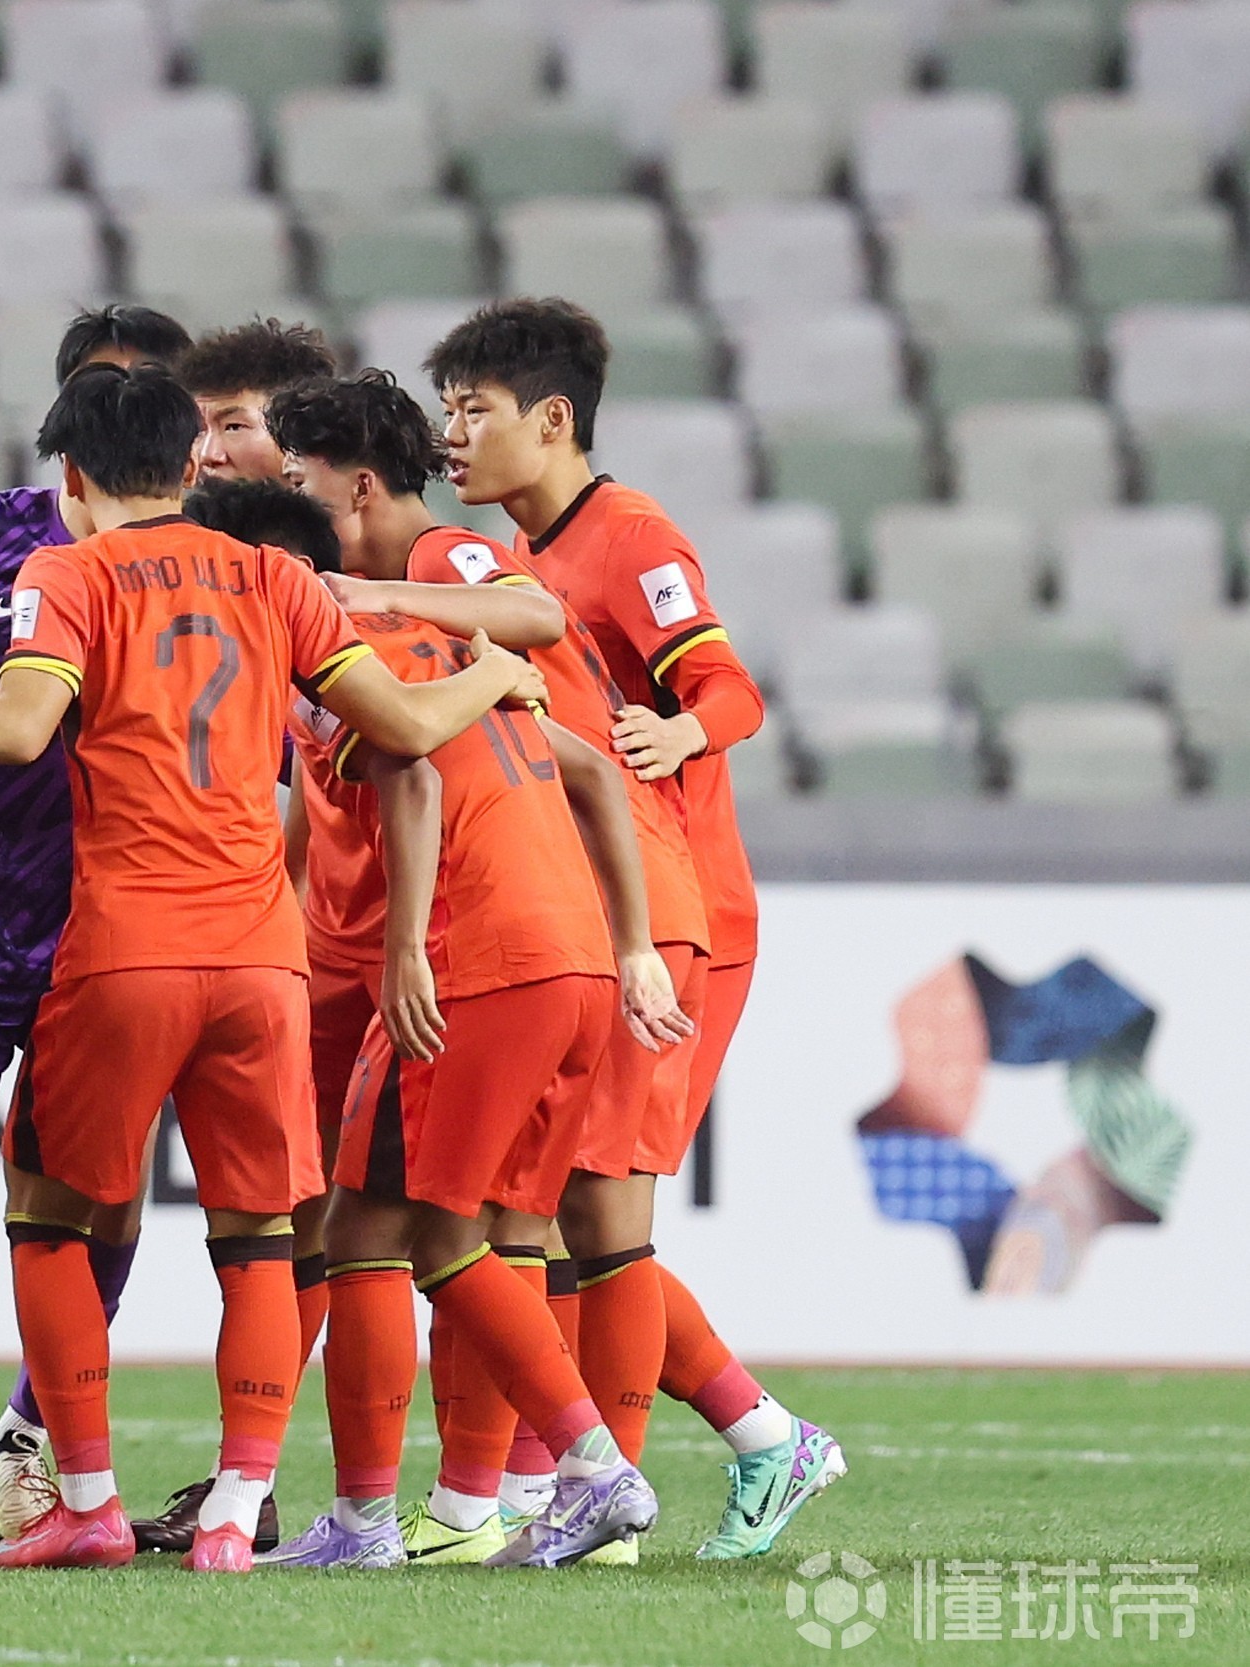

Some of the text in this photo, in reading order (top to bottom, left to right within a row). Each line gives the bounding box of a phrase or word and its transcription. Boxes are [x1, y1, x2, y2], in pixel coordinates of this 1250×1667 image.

[115, 556, 182, 592] MAO
[655, 583, 682, 605] AFC
[155, 613, 240, 789] 7
[235, 1380, 285, 1399] 中国
